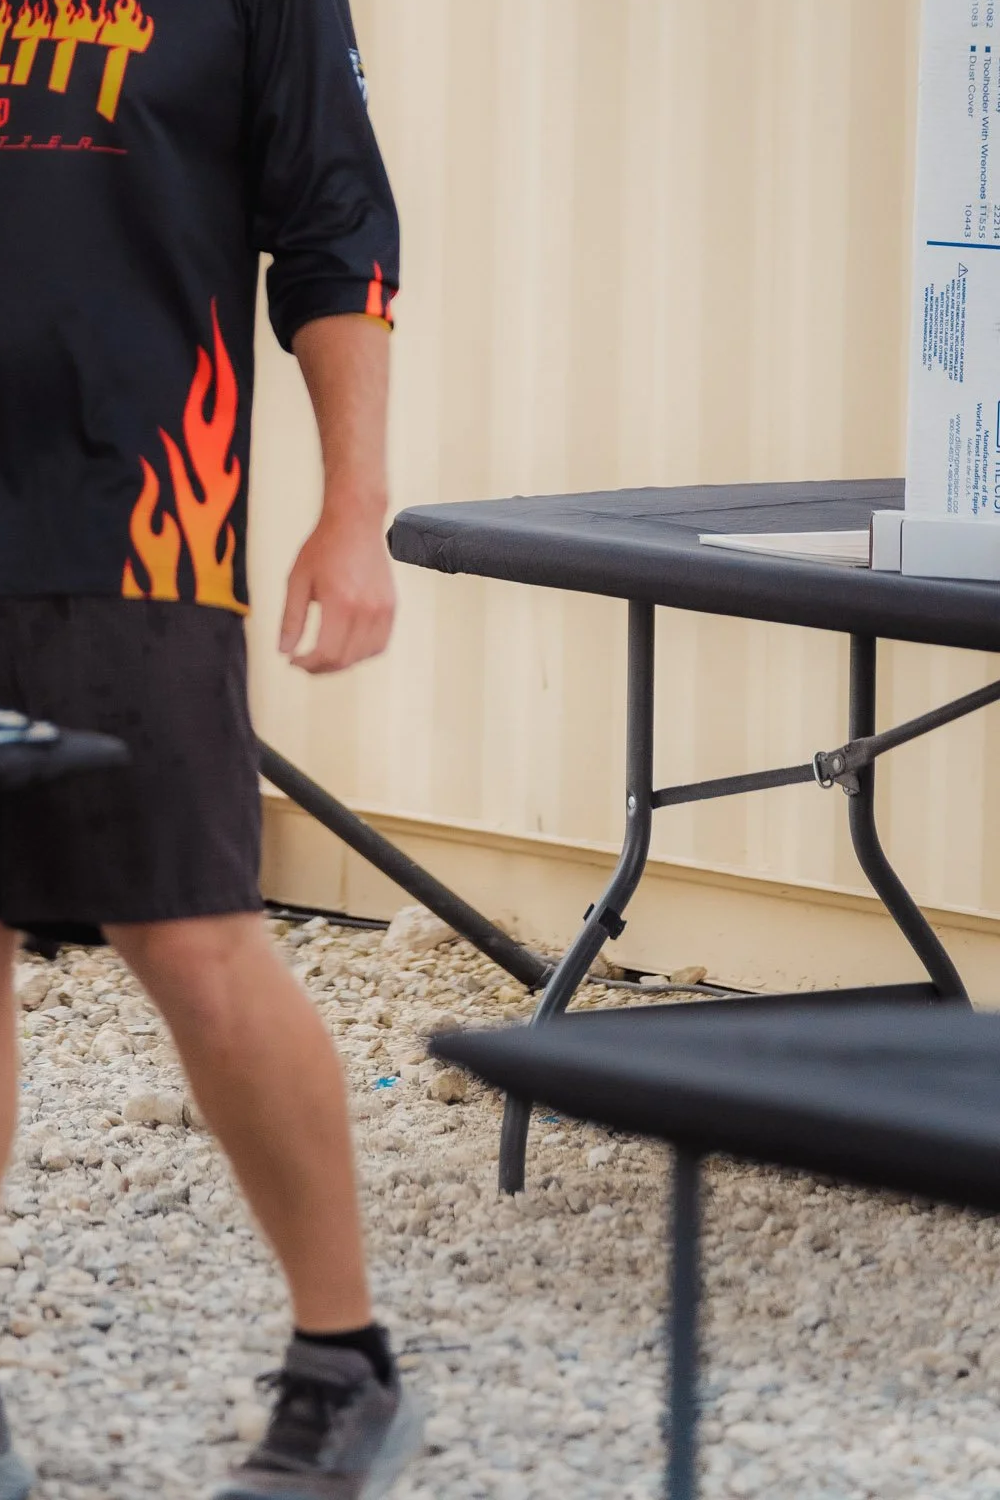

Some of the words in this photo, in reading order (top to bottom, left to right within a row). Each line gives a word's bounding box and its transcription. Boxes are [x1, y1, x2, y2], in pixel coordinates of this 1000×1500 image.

[969, 55, 977, 81] Dust
[967, 84, 976, 119] Cover
[982, 57, 992, 114] Toolholder
[981, 116, 990, 141] With
[980, 144, 989, 200] Wrenches
[964, 203, 972, 238] 10443
[978, 204, 987, 239] 11555
[975, 402, 983, 432] World's
[974, 434, 982, 457] Finest
[982, 429, 990, 482] Manufacturer
[972, 459, 981, 490] Loading
[982, 484, 989, 494] of
